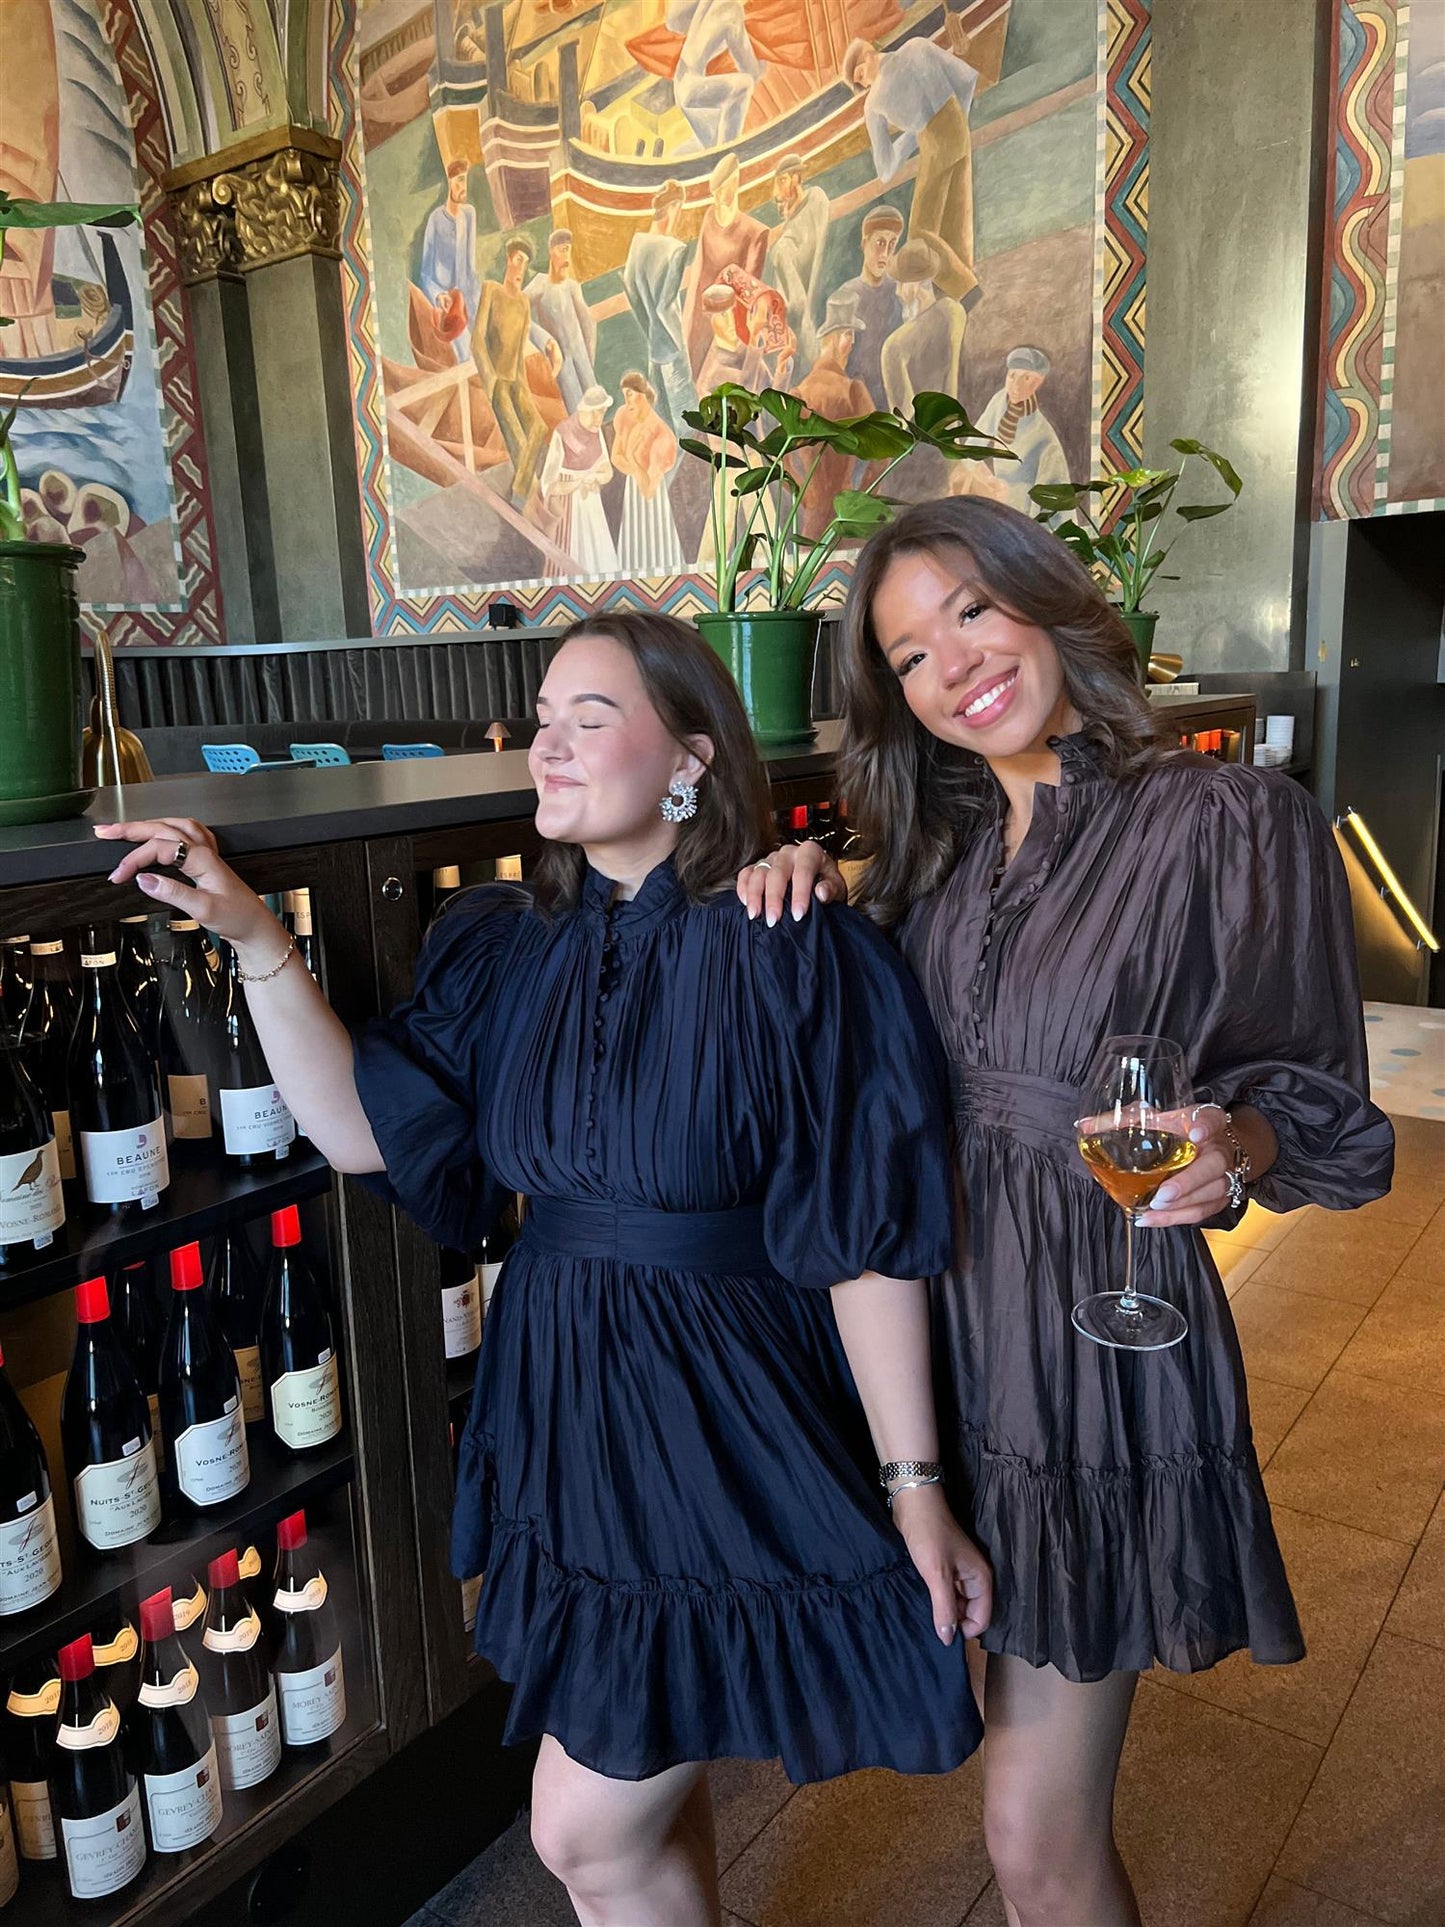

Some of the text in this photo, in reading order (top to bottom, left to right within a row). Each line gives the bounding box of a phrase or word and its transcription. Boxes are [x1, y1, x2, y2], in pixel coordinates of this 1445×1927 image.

[117, 1146, 161, 1166] BEAUNE
[130, 1504, 147, 1518] 2020
[24, 1567, 44, 1582] 2020
